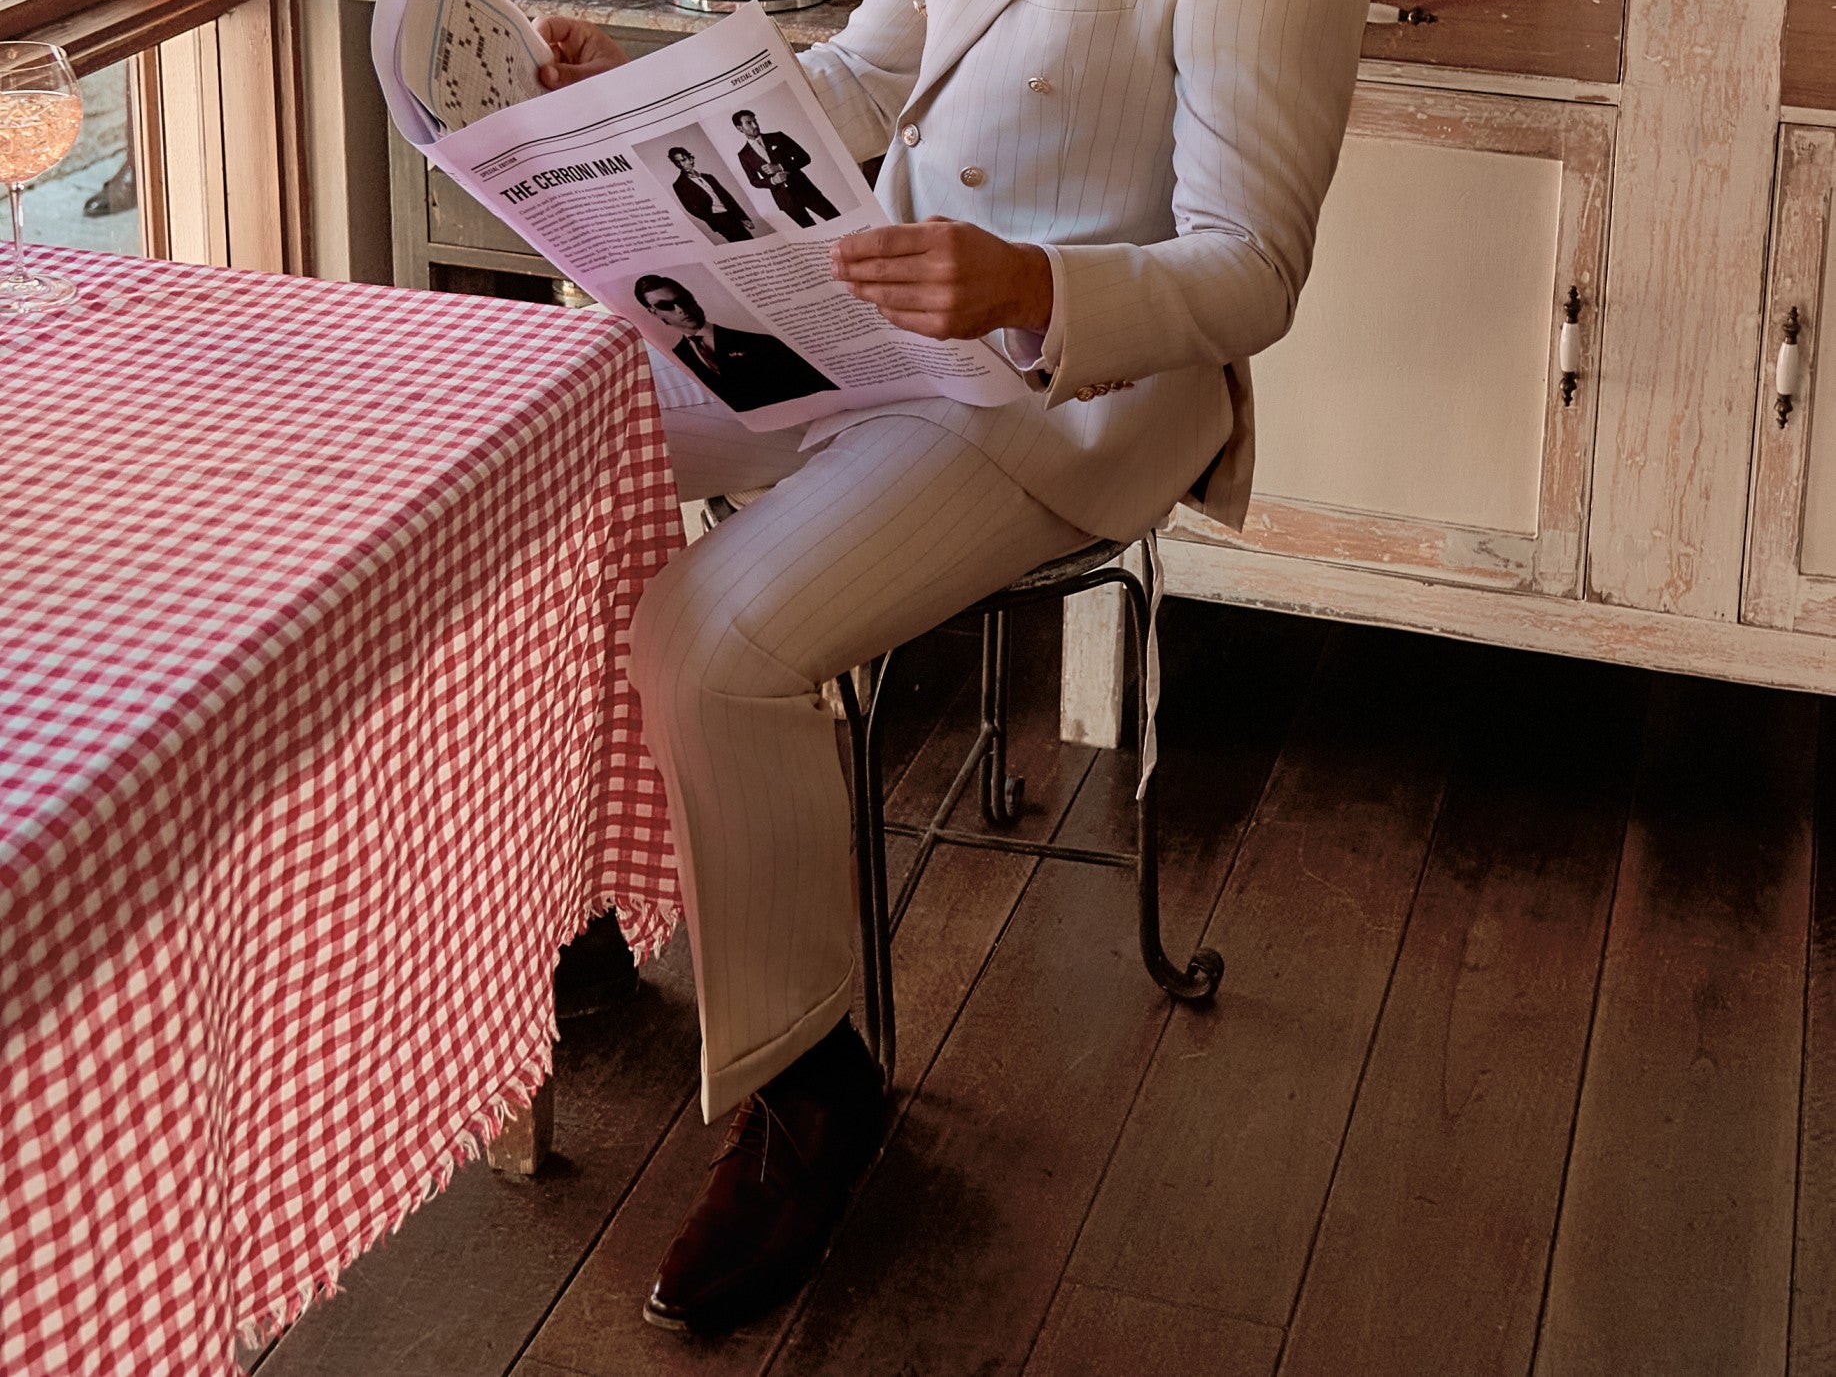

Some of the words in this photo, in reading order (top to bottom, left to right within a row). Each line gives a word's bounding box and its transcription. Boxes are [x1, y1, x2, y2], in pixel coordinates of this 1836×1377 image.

[730, 72, 753, 86] SPECIAL
[751, 59, 773, 76] EDITION
[480, 165, 500, 178] SPECIAL
[498, 157, 518, 169] EDITION
[500, 180, 538, 204] THE
[532, 162, 599, 189] CERRONI
[592, 154, 633, 176] MAN
